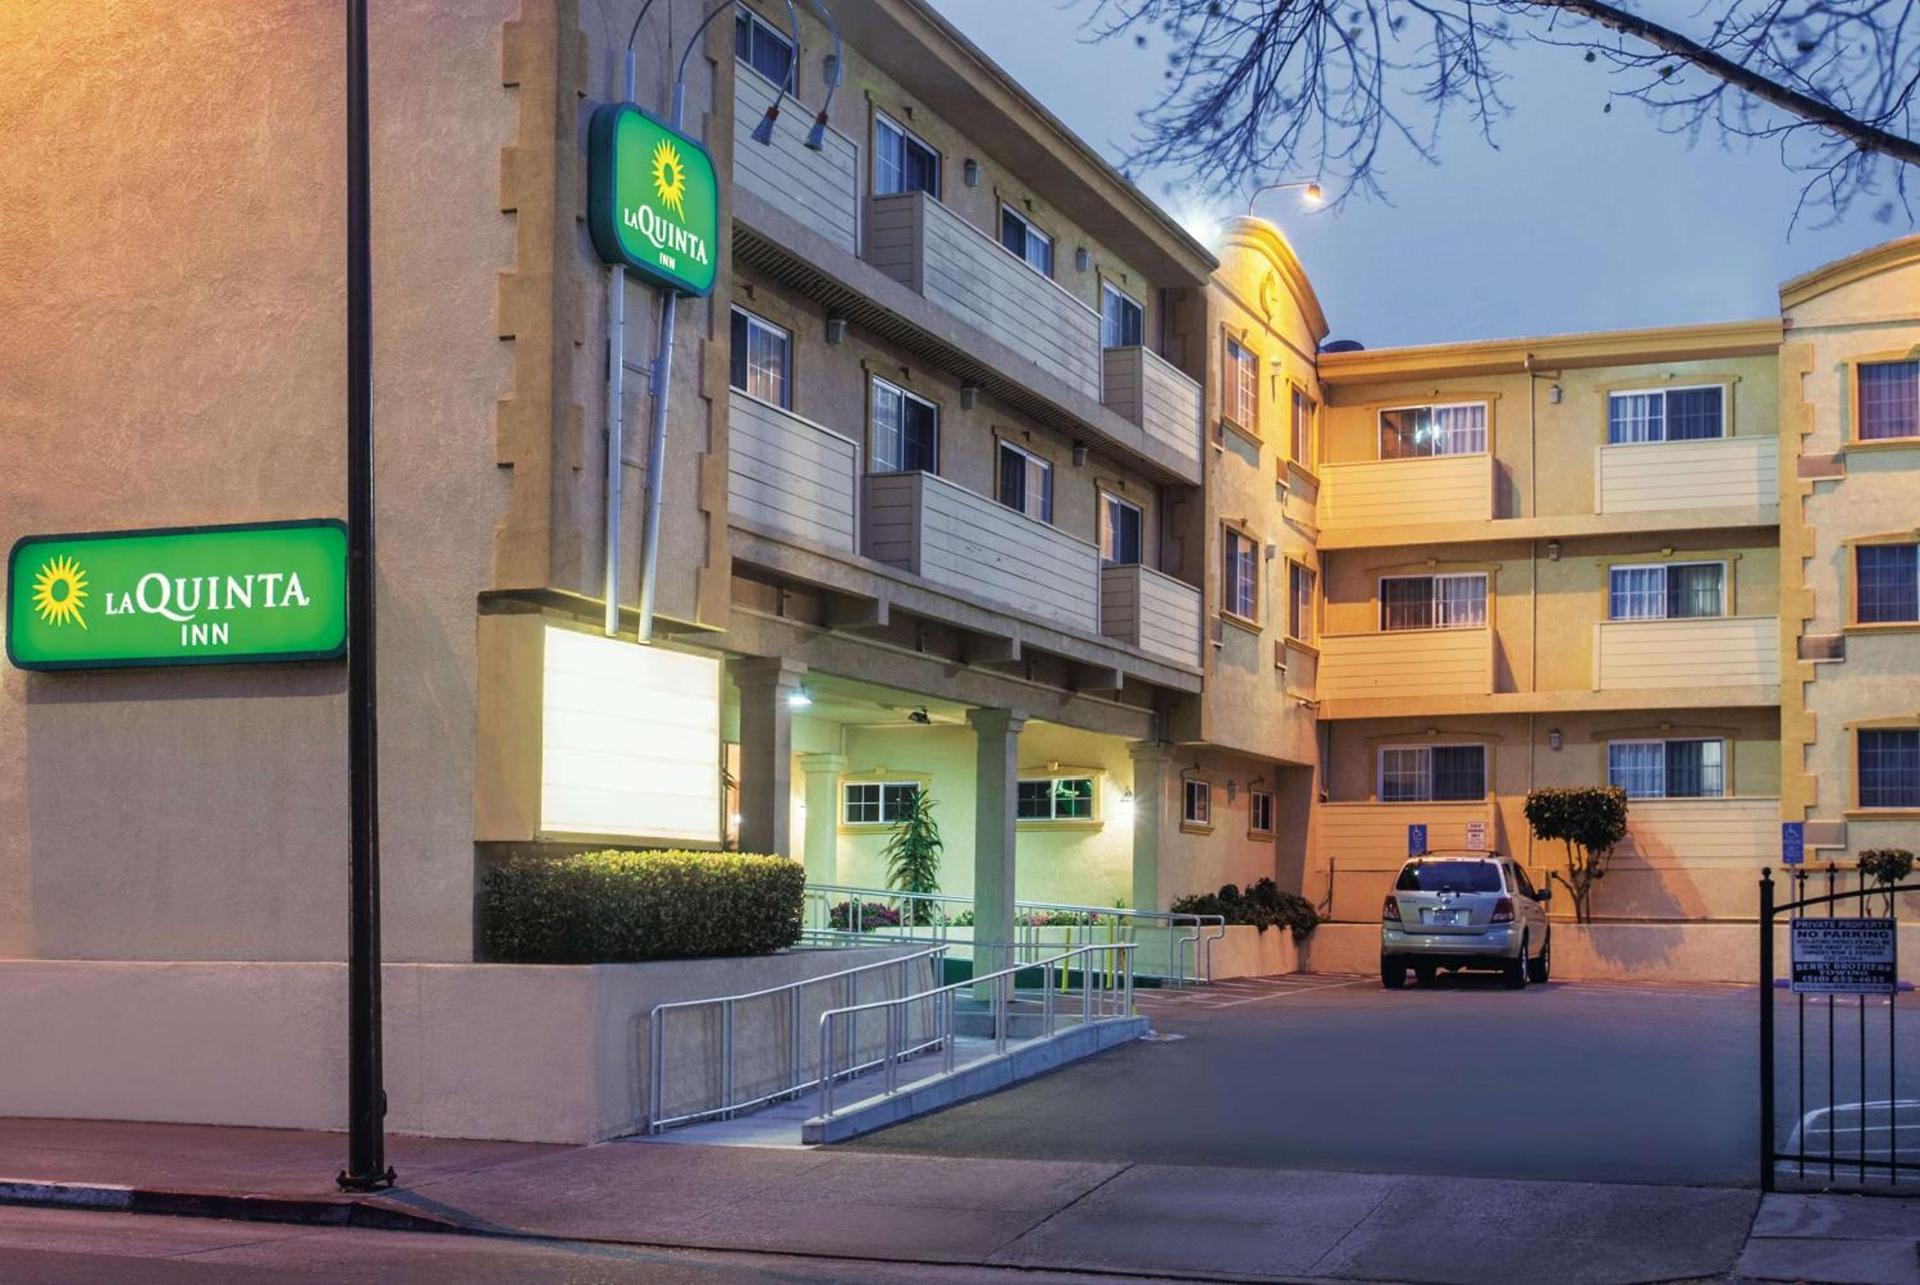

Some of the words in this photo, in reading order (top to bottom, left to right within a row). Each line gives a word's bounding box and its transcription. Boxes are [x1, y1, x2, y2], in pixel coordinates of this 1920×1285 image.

[624, 208, 639, 230] LA
[638, 205, 708, 265] QUINTA
[659, 252, 676, 269] INN
[105, 592, 135, 615] LA
[135, 571, 310, 622] QUINTA
[181, 622, 229, 646] INN
[1795, 921, 1835, 929] PRIVATE
[1838, 921, 1890, 929] PROPERTY
[1797, 930, 1818, 938] NO
[1823, 930, 1889, 938] PARKING
[1795, 963, 1830, 971] BERRY
[1833, 963, 1892, 972] BROTHERS
